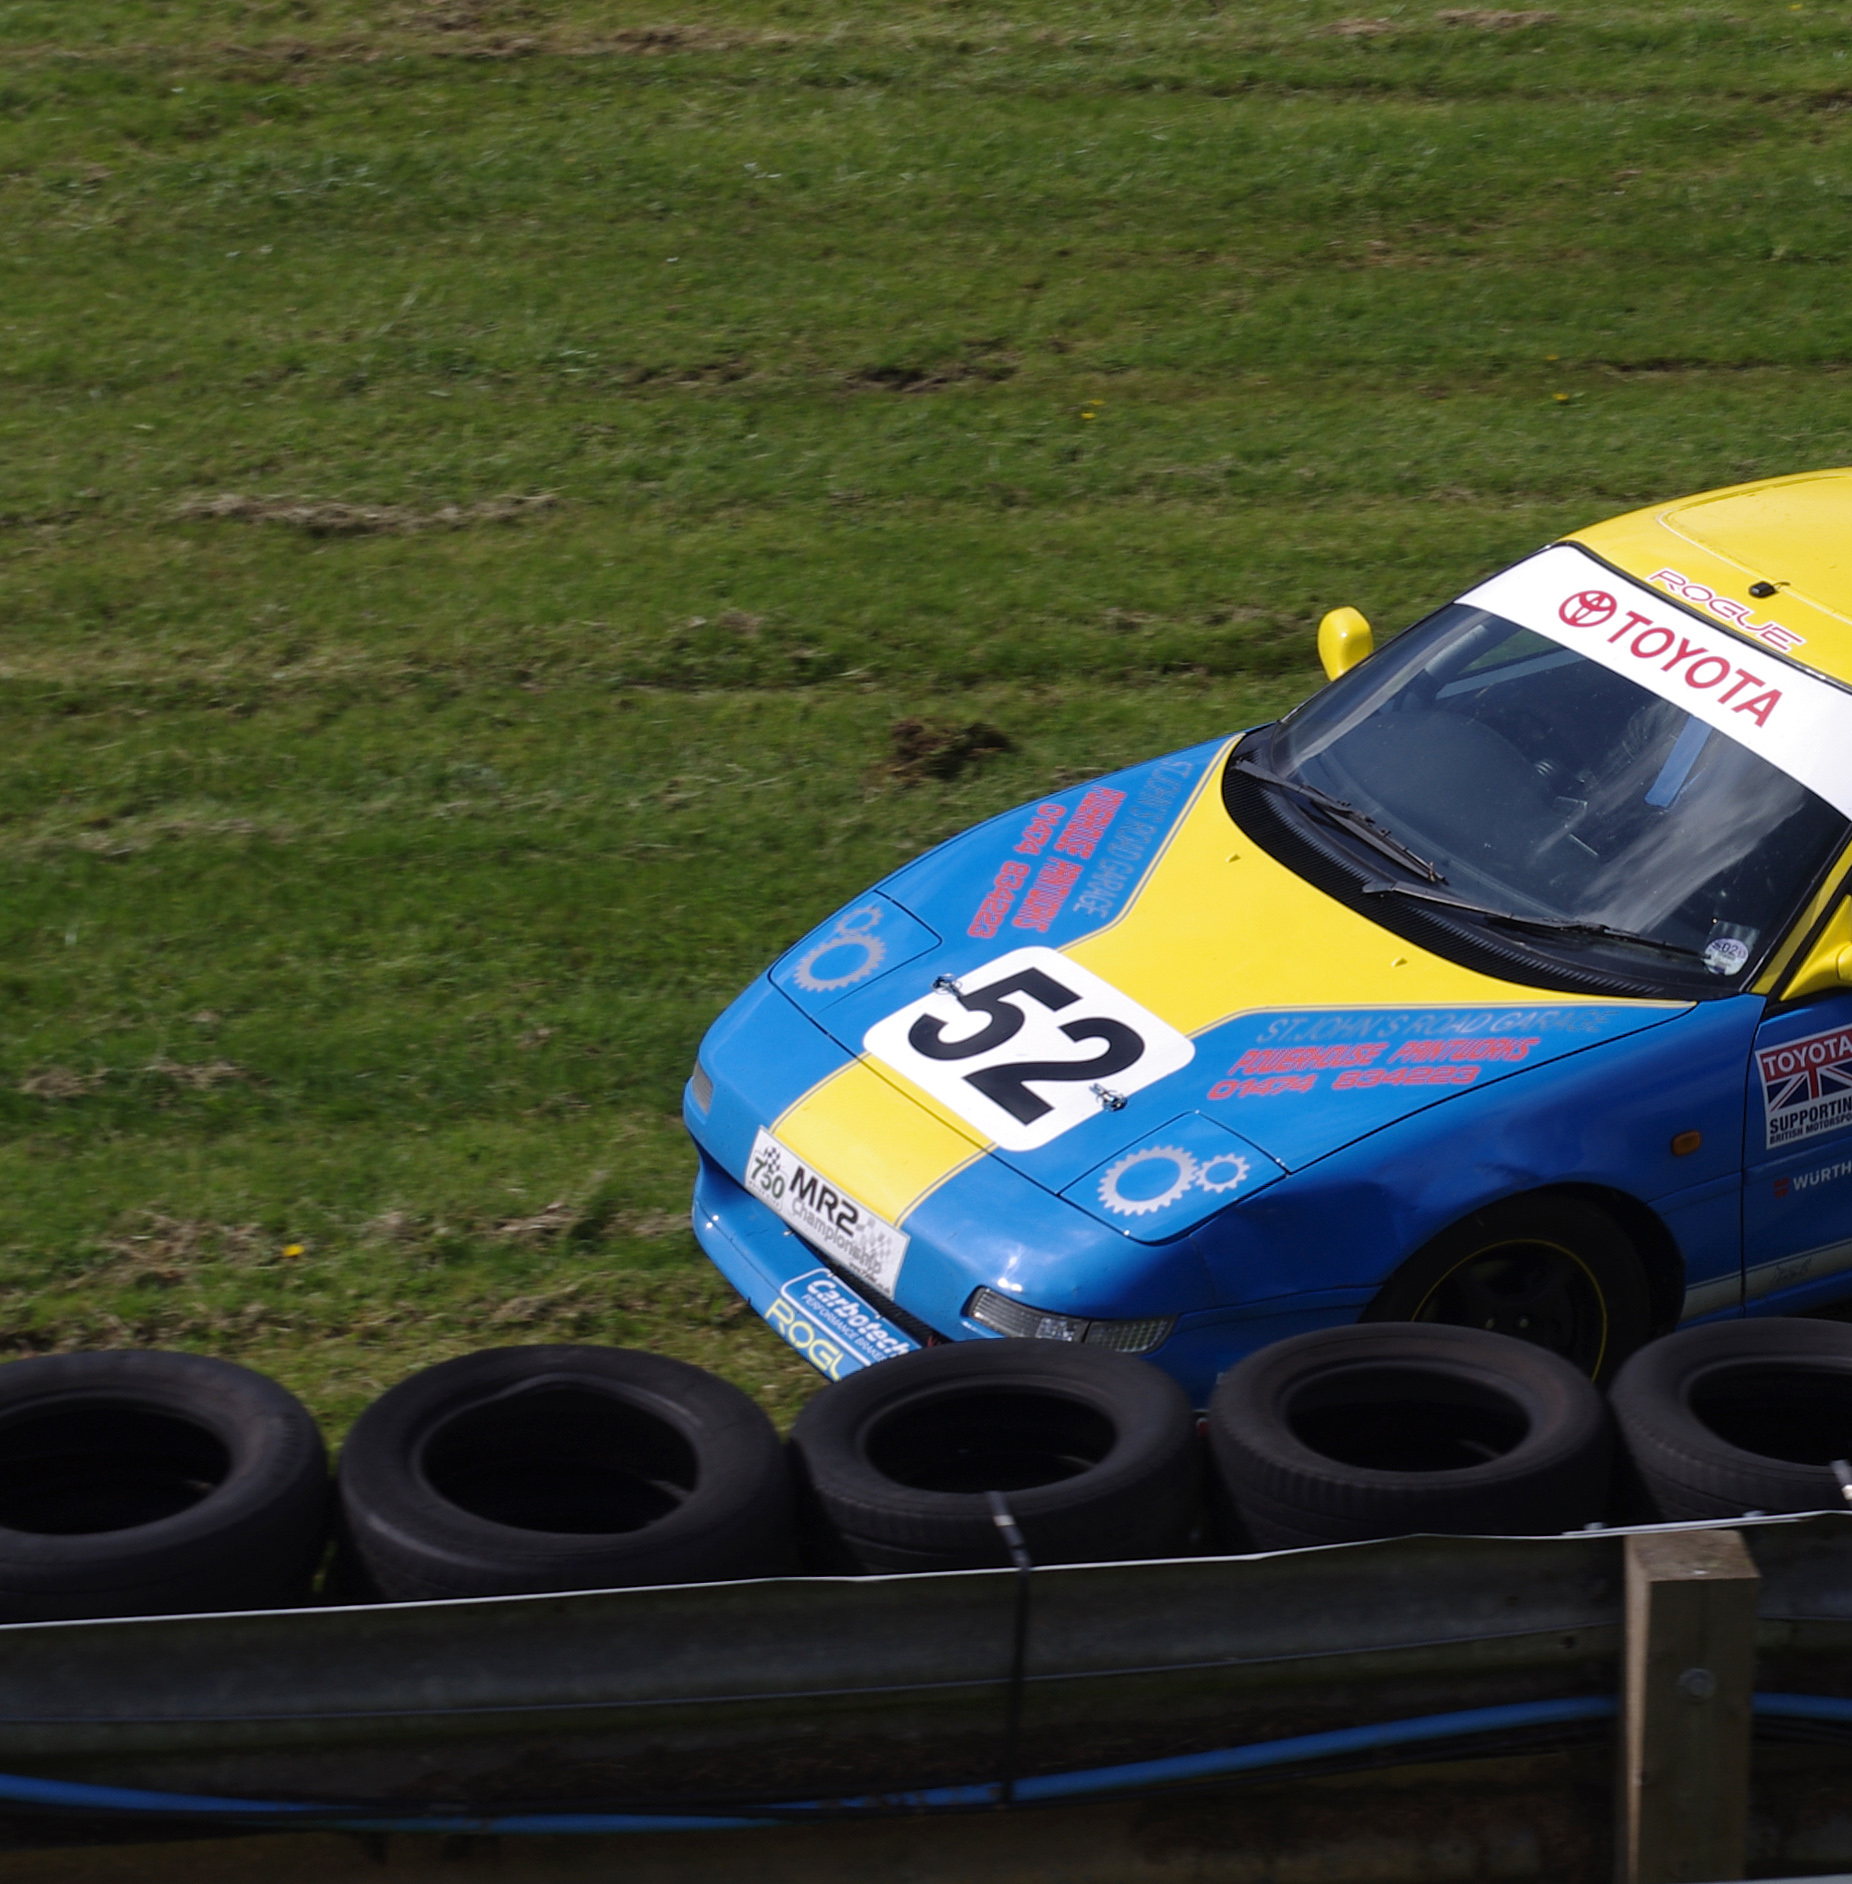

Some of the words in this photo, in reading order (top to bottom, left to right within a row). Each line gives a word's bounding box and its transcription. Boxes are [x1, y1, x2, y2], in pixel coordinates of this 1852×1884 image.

[1648, 568, 1805, 652] ROGUE
[1606, 610, 1783, 728] TOYOTA
[1014, 803, 1067, 856] 01474
[967, 860, 1030, 939] 834223
[1073, 858, 1133, 918] GARAGE
[908, 967, 1145, 1125] 52
[1404, 1012, 1493, 1036] ROAD
[1491, 1010, 1620, 1033] GARAGE
[1207, 1073, 1318, 1100] 01474
[1332, 1064, 1482, 1090] 834223
[1228, 1041, 1390, 1076] POWERHOUSE
[1770, 1125, 1803, 1145] BRITISH
[750, 1157, 785, 1199] 750
[789, 1165, 859, 1238] MR2
[1793, 1160, 1852, 1191] WÜRTH
[791, 1200, 882, 1276] Championship
[801, 1294, 854, 1340] PERFORMANCE
[807, 1279, 910, 1357] Carbotech
